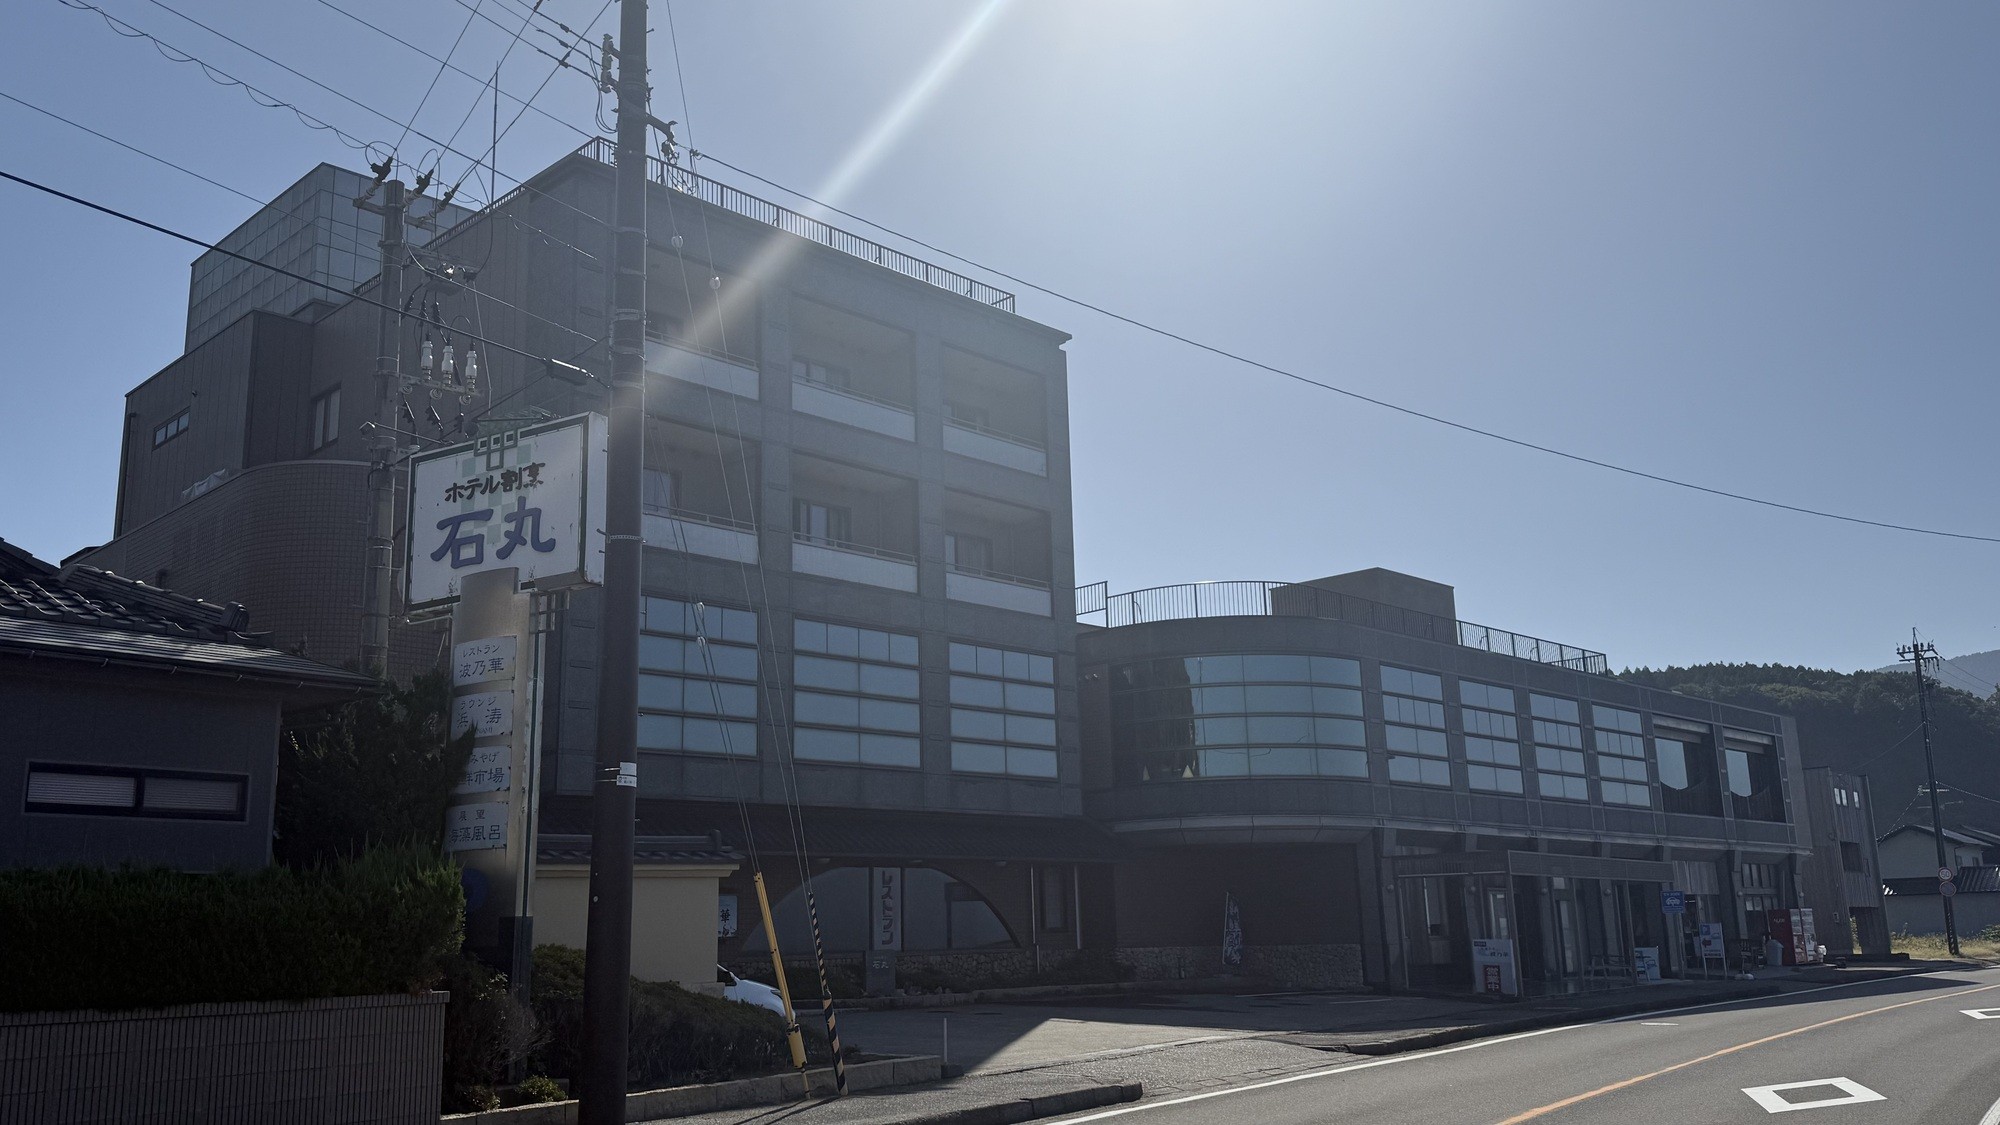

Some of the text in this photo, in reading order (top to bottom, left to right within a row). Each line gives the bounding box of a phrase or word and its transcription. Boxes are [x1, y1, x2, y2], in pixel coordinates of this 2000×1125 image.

[430, 496, 556, 569] 石丸
[463, 644, 500, 657] レストラン
[459, 657, 504, 678] 波乃華
[460, 696, 496, 710] ラウンジ
[471, 752, 500, 765] みやげ
[881, 870, 893, 945] レストラン
